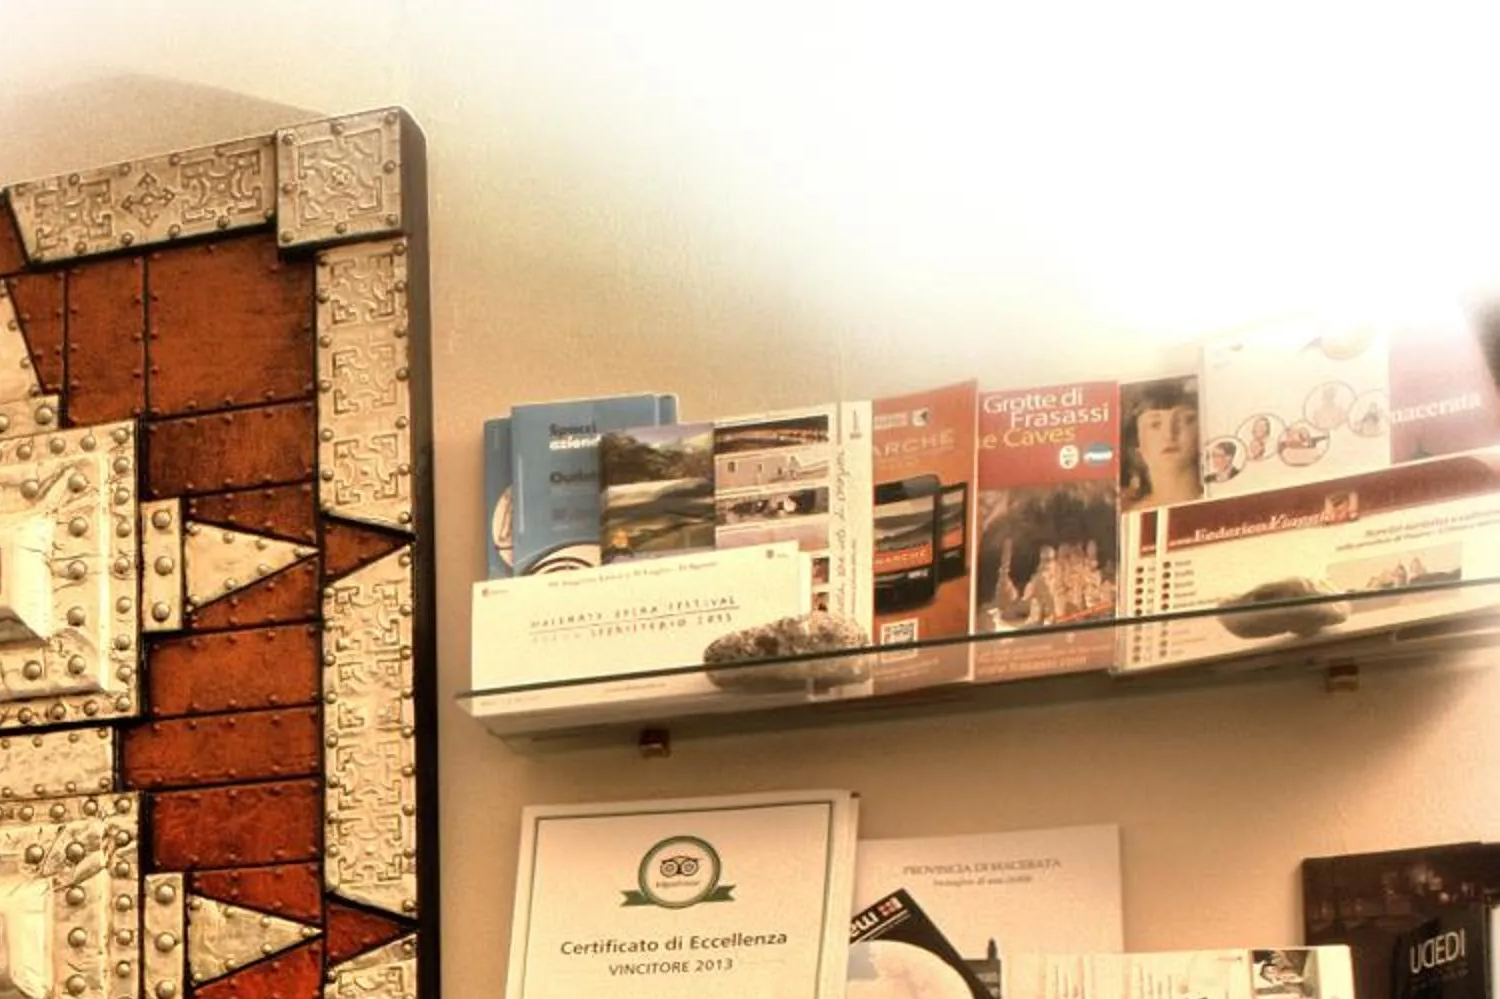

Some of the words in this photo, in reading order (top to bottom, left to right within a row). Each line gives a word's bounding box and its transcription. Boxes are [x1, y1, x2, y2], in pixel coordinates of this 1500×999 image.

[984, 391, 1056, 414] Grotte
[1061, 387, 1084, 407] di
[1010, 403, 1110, 431] Frasassi
[872, 428, 956, 458] ARCHE
[1003, 425, 1077, 449] Caves
[560, 937, 660, 957] Certificato
[665, 936, 684, 952] di
[690, 931, 789, 952] Eccellenza
[608, 961, 690, 977] VINCITORE
[695, 957, 734, 973] 2013
